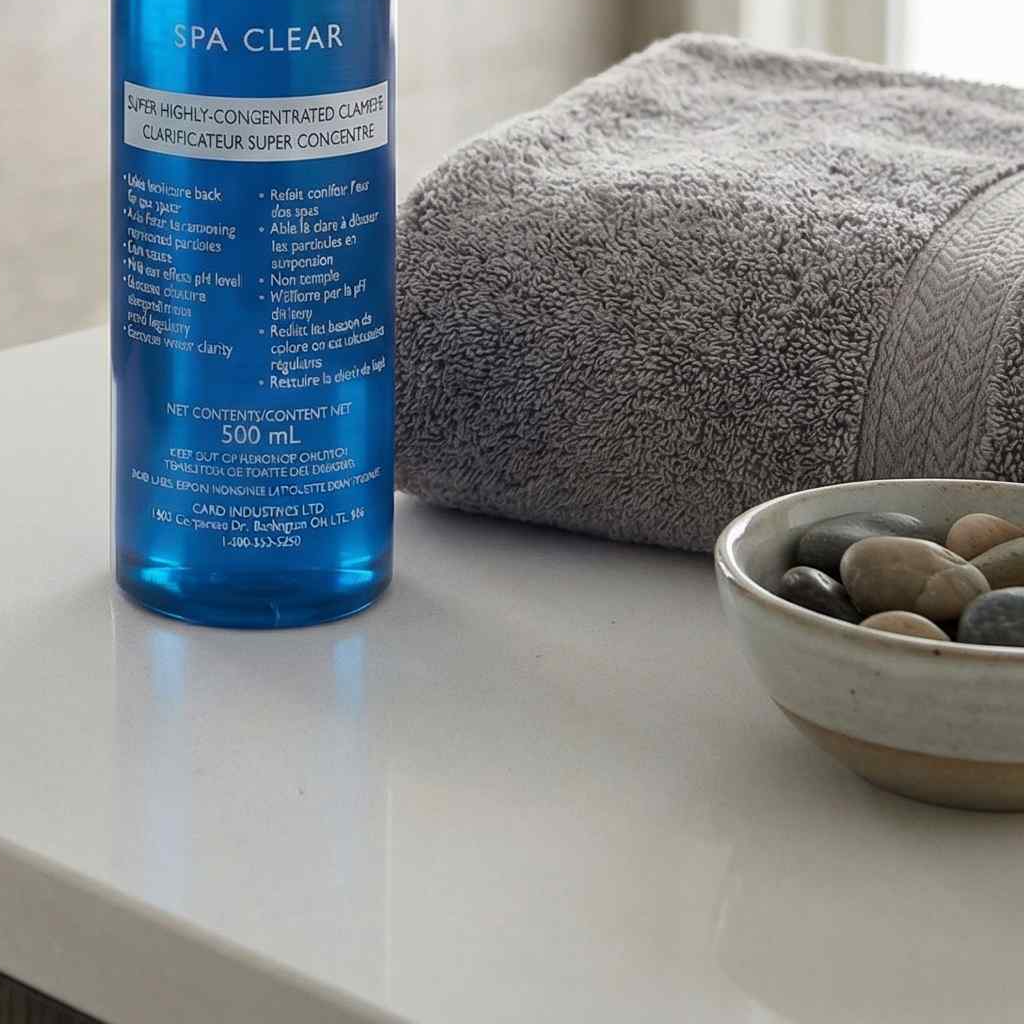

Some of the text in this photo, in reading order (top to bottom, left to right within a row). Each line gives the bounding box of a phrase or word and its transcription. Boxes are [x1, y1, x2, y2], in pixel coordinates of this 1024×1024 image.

[174, 23, 344, 52] SPA CLEAR
[142, 122, 375, 151] CLARIFICATEUR SUPER CONCENTRE
[194, 186, 224, 202] back
[270, 273, 296, 287] Non
[166, 402, 189, 417] NET
[192, 406, 328, 423] CONTENTS/CONTENT
[221, 424, 302, 445] 500 mL
[302, 502, 325, 517] LTD
